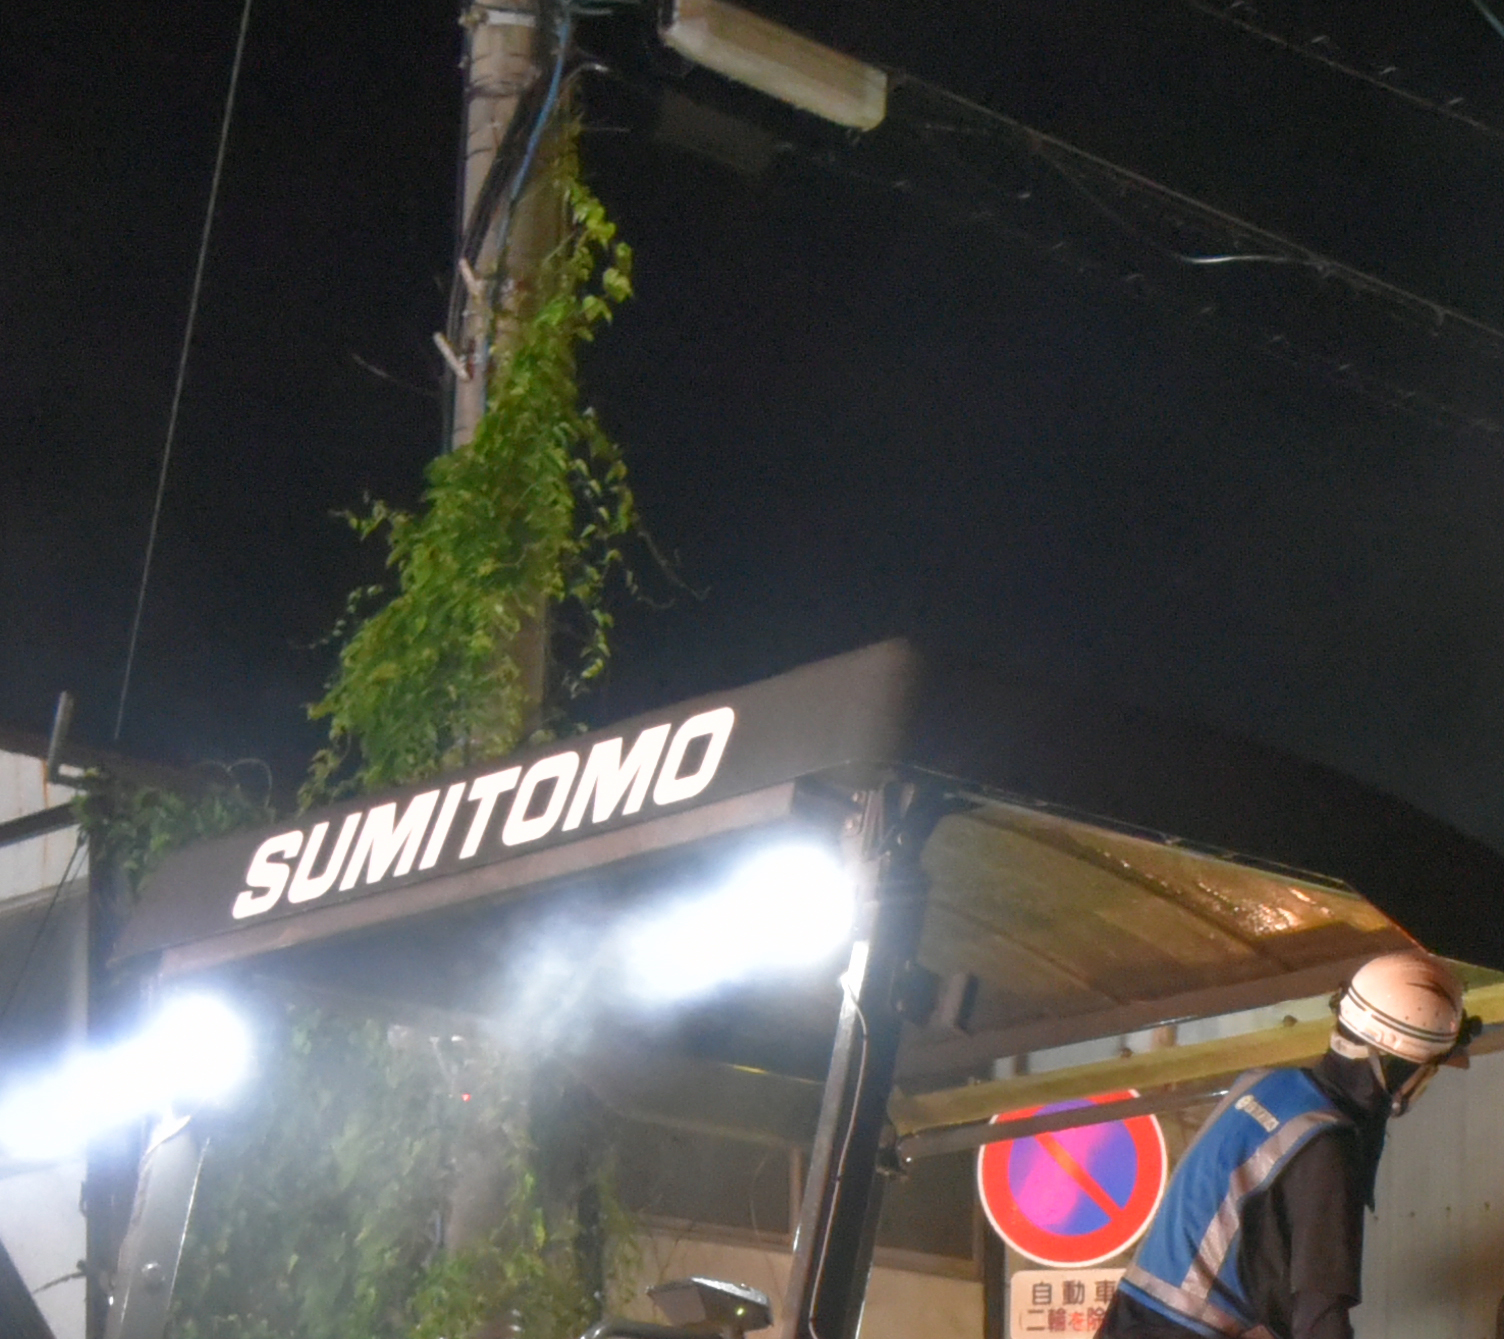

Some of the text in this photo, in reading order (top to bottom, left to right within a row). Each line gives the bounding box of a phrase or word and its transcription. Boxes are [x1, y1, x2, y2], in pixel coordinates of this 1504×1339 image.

[232, 706, 736, 919] SUMITOMO
[1031, 1280, 1117, 1306] 自動車
